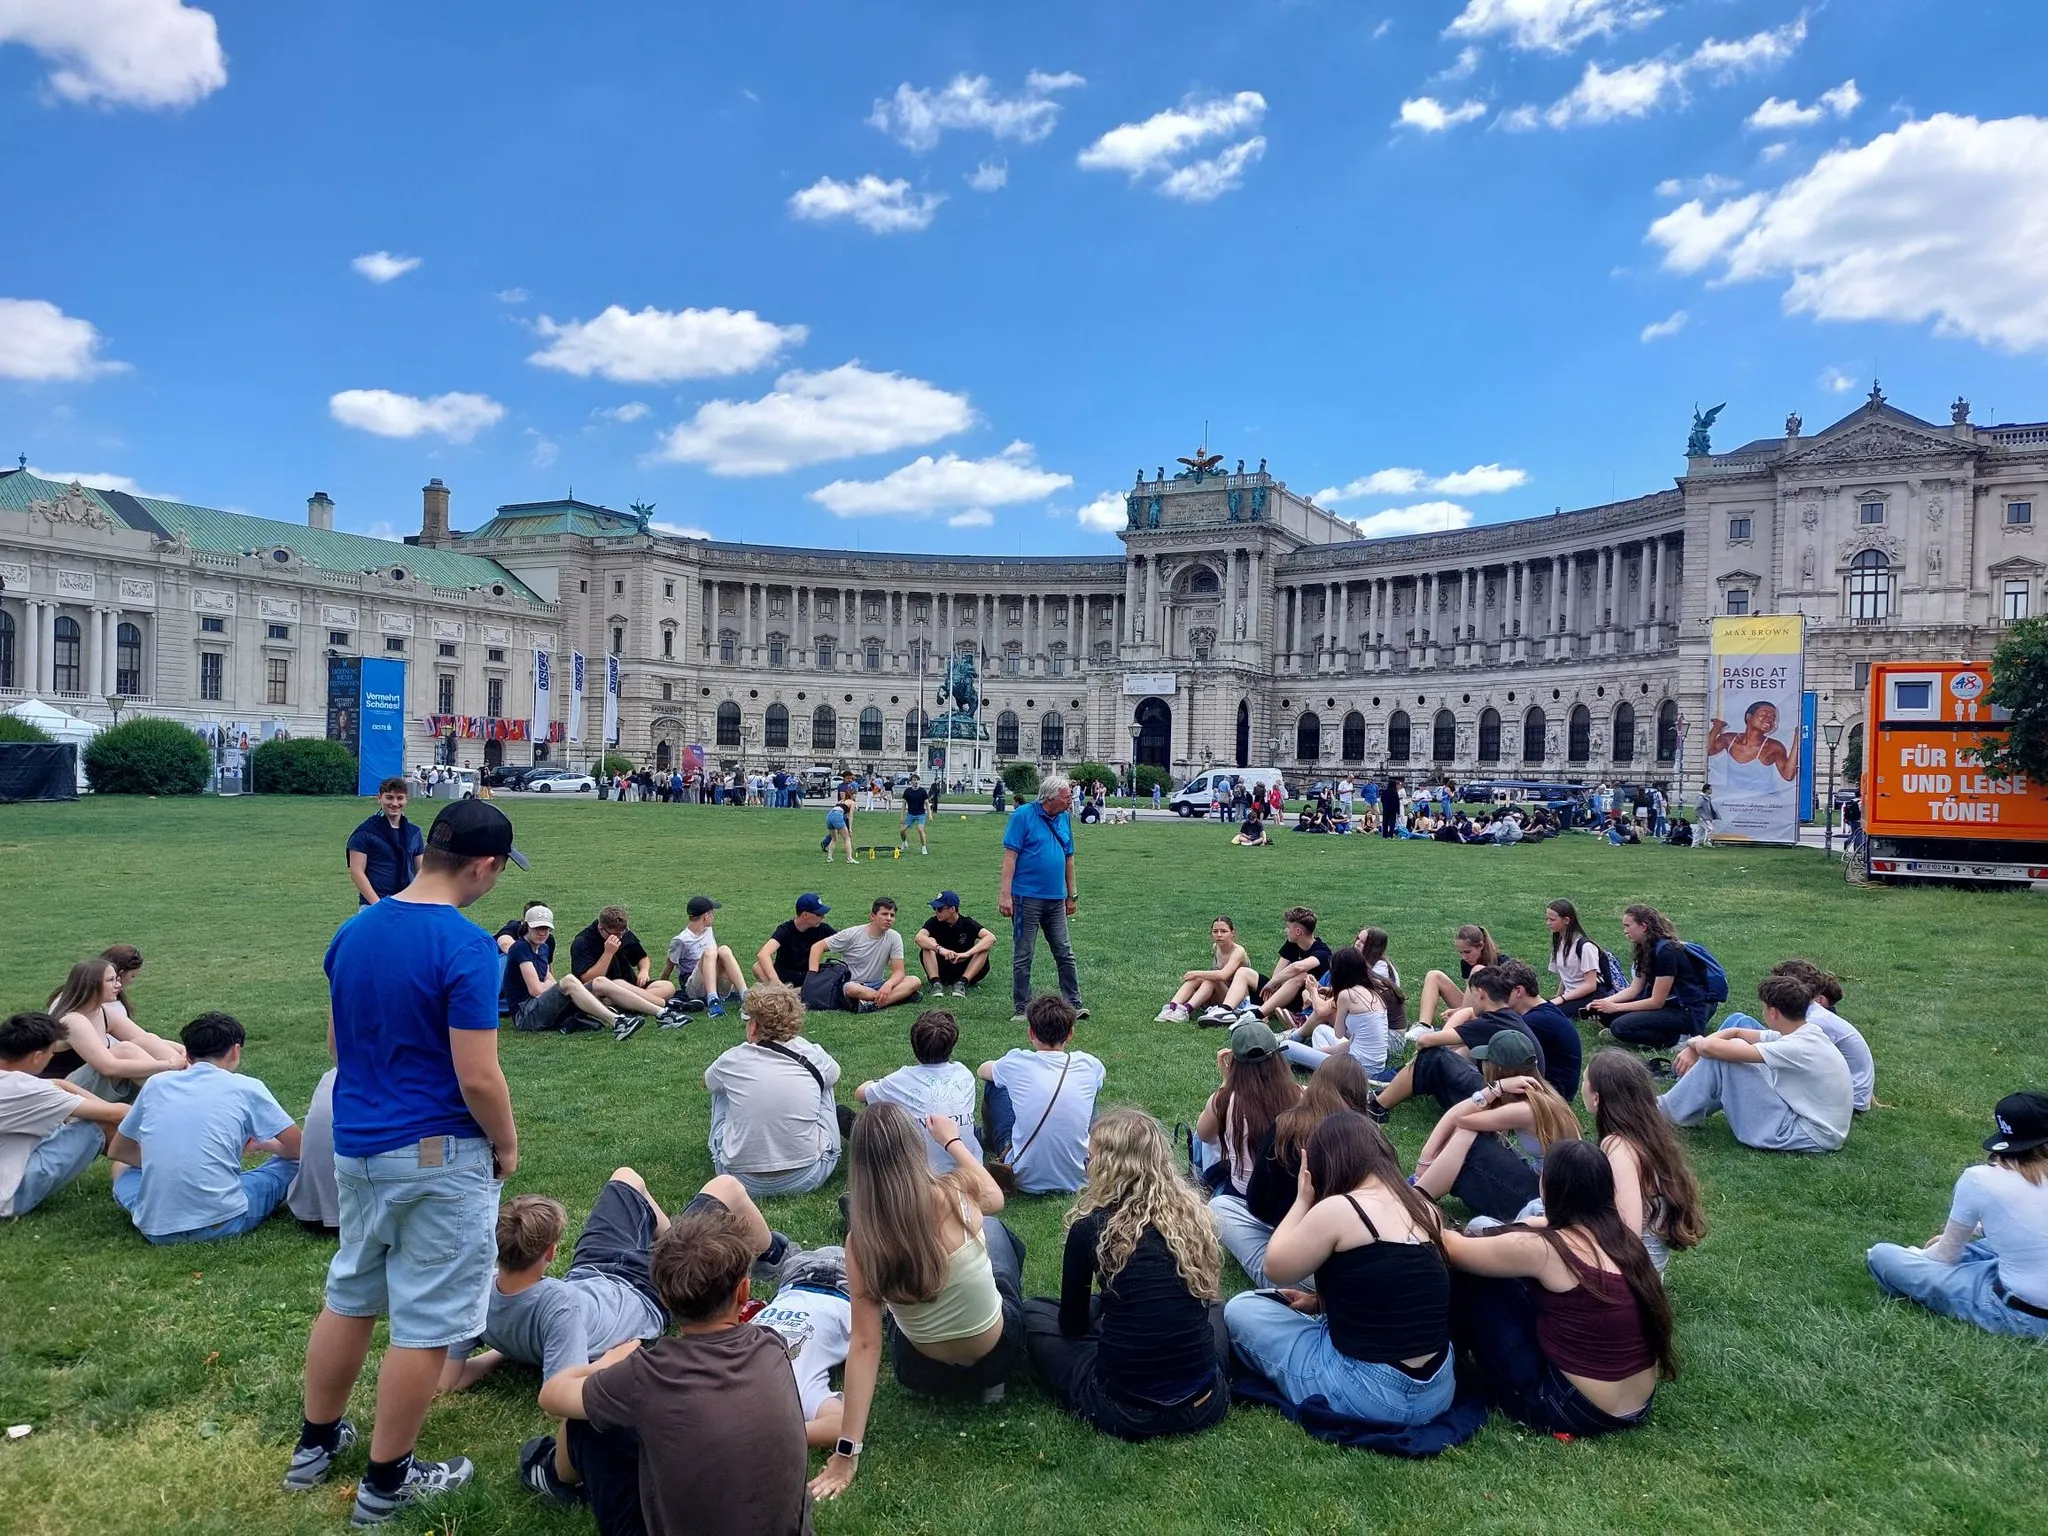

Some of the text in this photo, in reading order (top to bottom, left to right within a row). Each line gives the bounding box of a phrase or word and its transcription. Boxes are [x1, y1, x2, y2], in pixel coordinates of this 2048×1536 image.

[1723, 667, 1788, 677] BASIC AT
[1723, 679, 1786, 689] ITS BEST
[365, 692, 400, 702] Vermehrt
[365, 700, 400, 709] Schönes!
[1900, 743, 1946, 767] FÜR
[1902, 774, 2028, 795] UND LEISE
[1928, 797, 1999, 822] TÖNE!
[1996, 1115, 2013, 1134] LA
